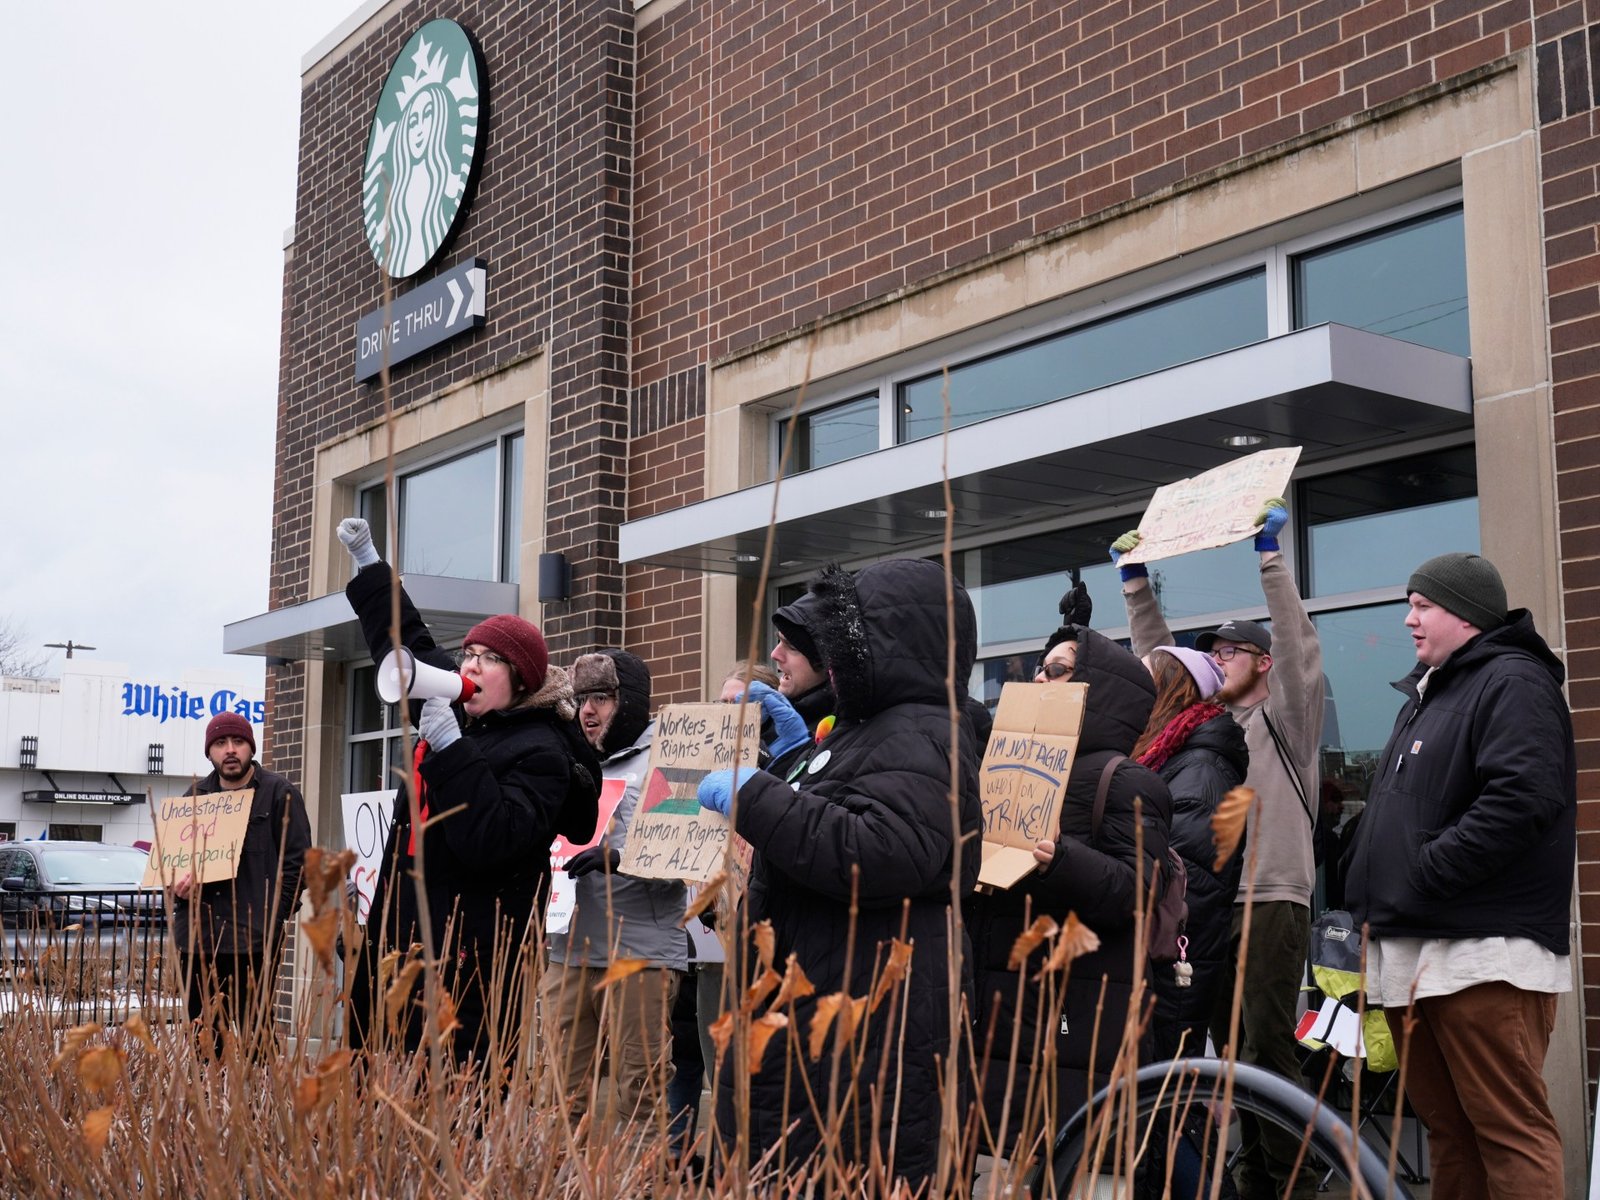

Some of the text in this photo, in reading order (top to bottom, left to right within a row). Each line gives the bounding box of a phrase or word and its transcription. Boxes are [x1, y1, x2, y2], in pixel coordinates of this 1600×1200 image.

[361, 297, 443, 360] DRIVE THRU
[122, 682, 205, 724] White
[658, 713, 706, 737] Workers
[660, 739, 700, 766] Rights
[1006, 738, 1040, 761] JUST
[180, 816, 217, 842] and
[633, 820, 729, 850] Human Rights
[150, 838, 238, 873] Underpaid
[636, 846, 661, 868] for
